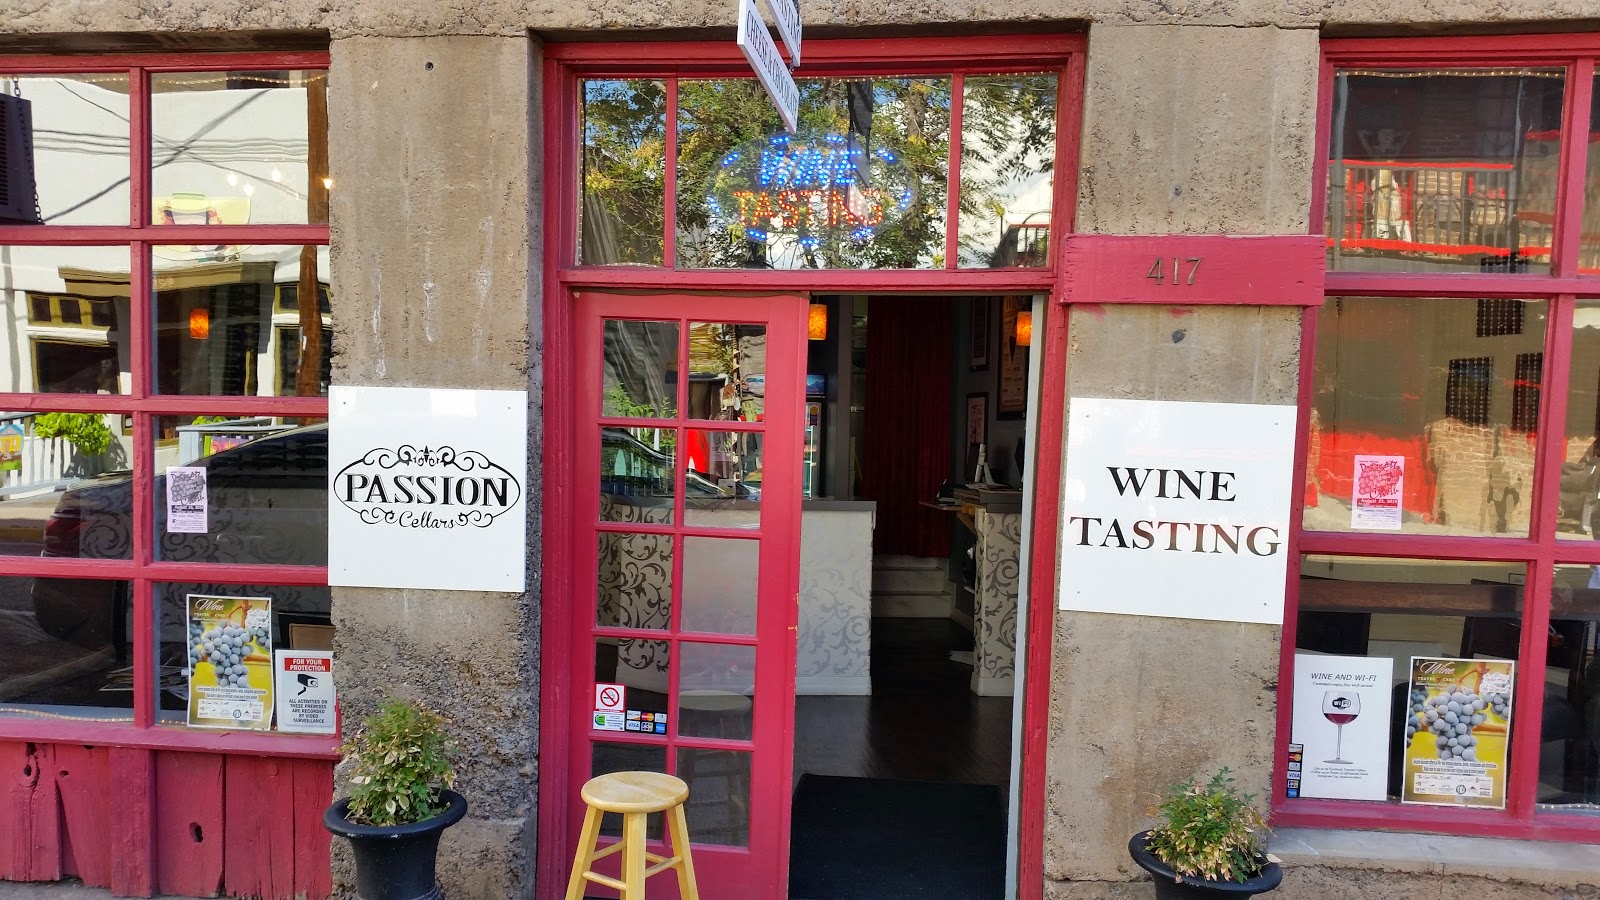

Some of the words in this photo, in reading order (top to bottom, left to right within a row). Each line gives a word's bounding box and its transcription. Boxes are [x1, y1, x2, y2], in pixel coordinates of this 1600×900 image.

[746, 10, 769, 69] CHEESE
[760, 150, 862, 185] WINE
[732, 190, 884, 227] TASTING
[1145, 256, 1204, 286] 417
[343, 473, 511, 506] PASSION
[1106, 466, 1237, 502] WINE
[399, 510, 455, 529] Cellars
[1069, 516, 1282, 557] TASTING
[195, 599, 225, 611] Wine
[1355, 674, 1377, 682] WI-FI
[1420, 661, 1456, 675] Wine
